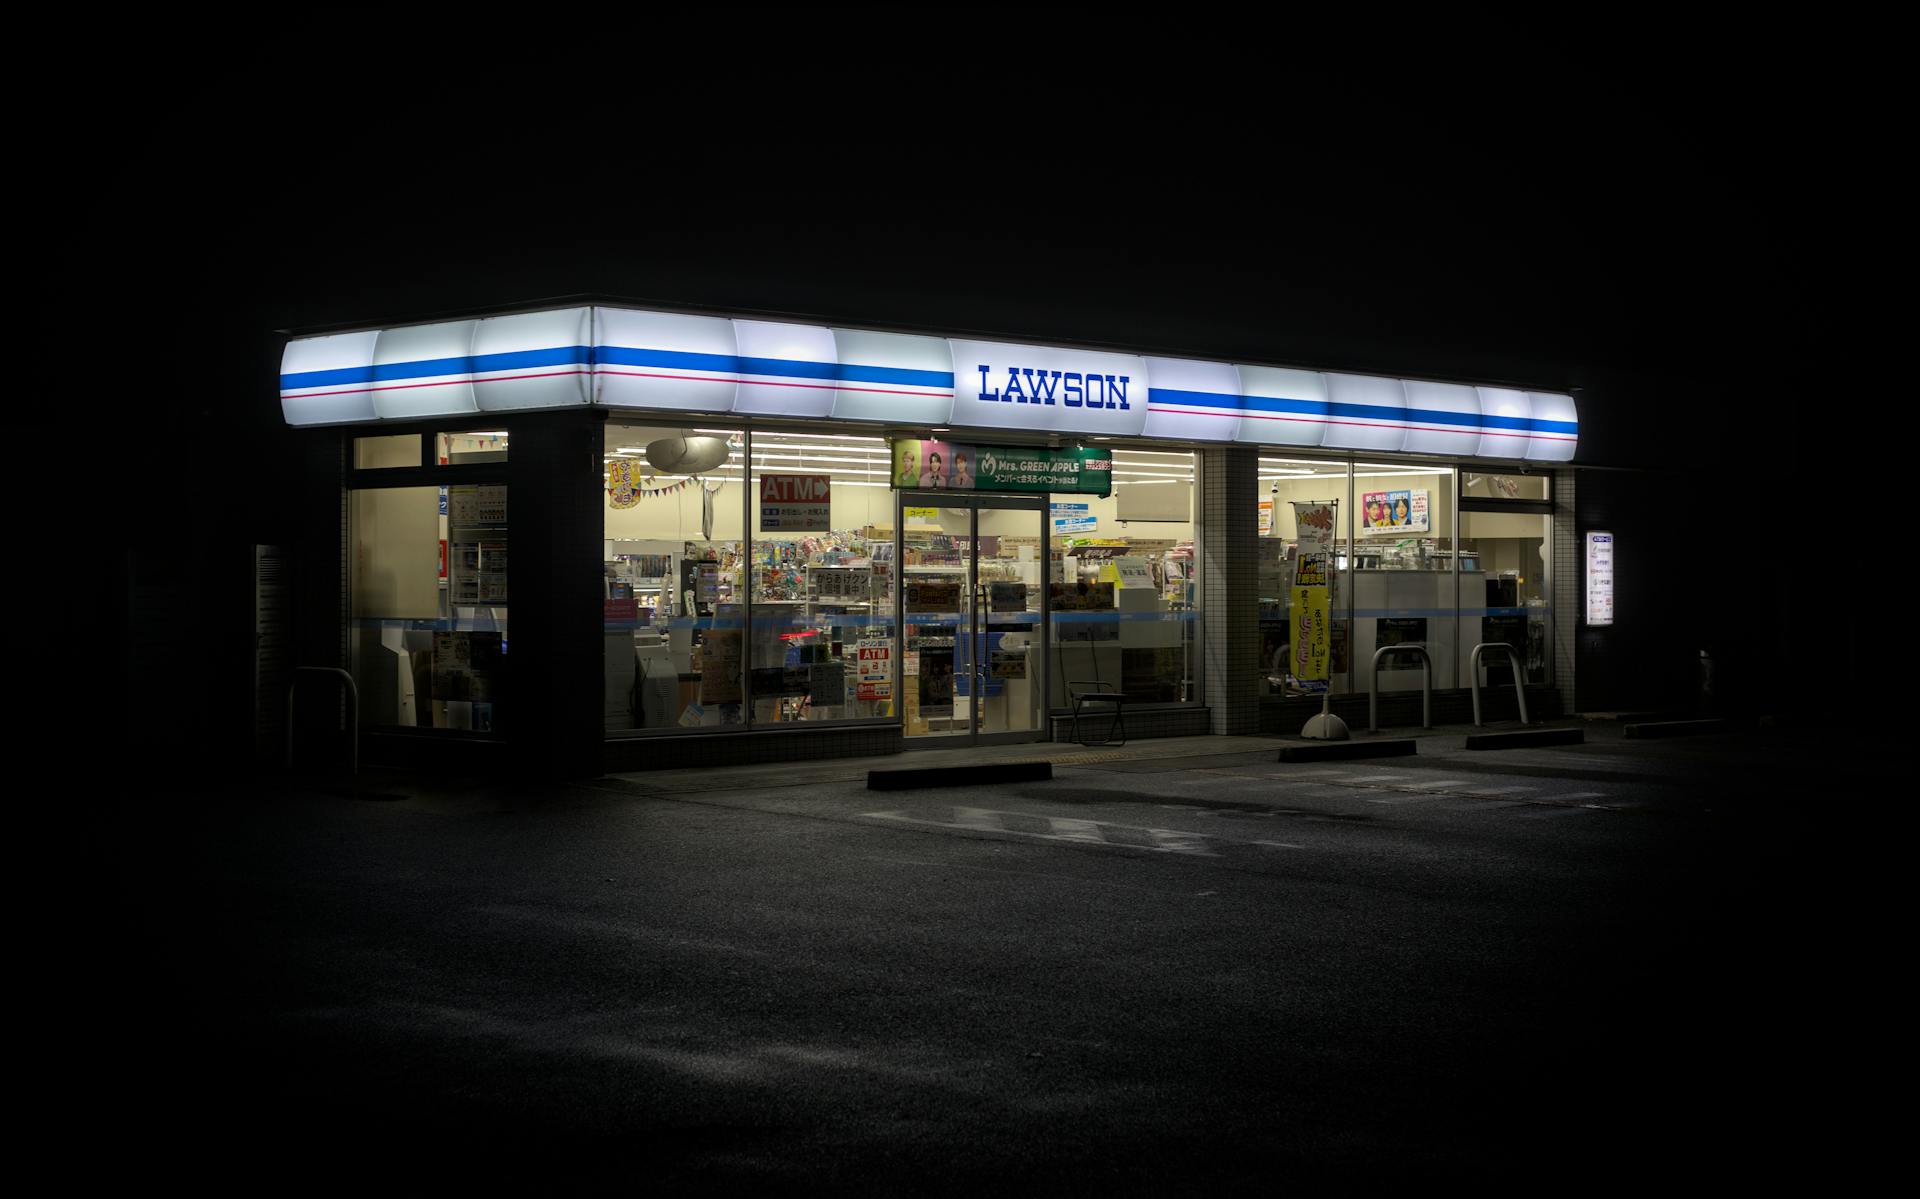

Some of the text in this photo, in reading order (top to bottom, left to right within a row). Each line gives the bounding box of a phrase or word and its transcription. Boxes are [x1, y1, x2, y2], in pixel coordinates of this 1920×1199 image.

[978, 364, 1130, 410] LAWSON
[999, 460, 1018, 471] Mrs.
[1020, 461, 1051, 473] GREEN
[1051, 462, 1080, 473] APPLE
[762, 477, 813, 500] ATM
[863, 649, 886, 660] ATM
